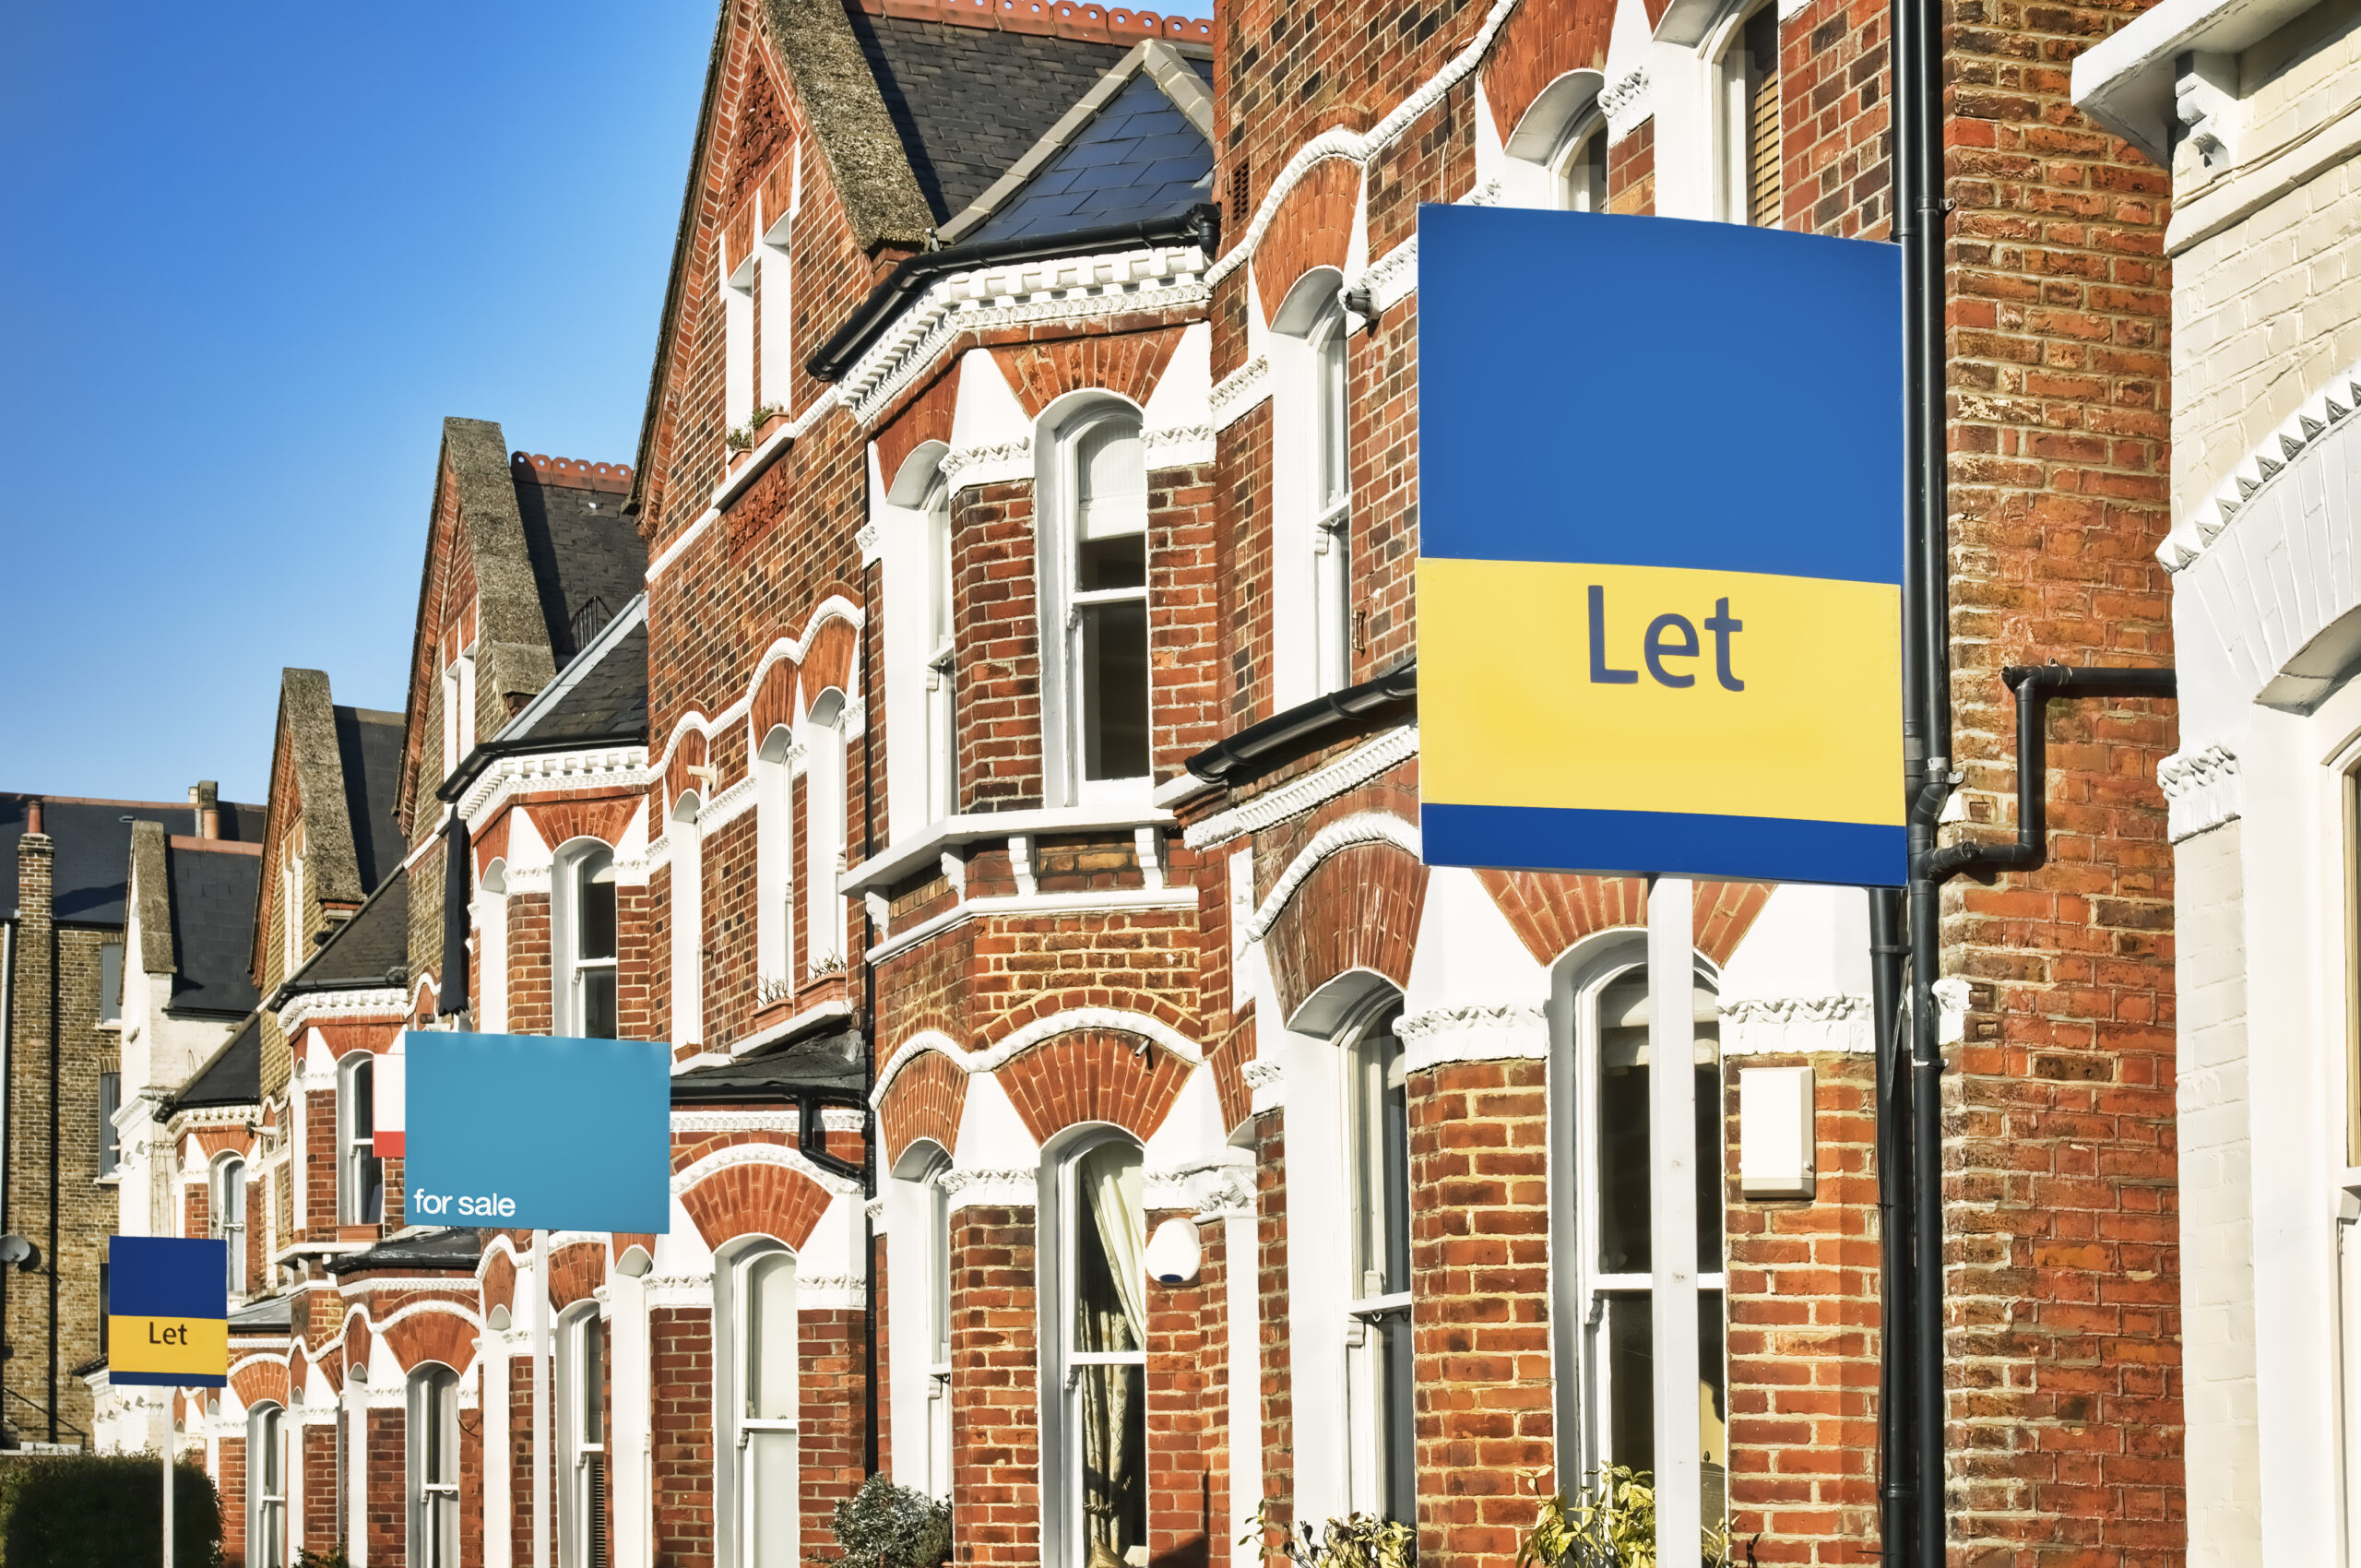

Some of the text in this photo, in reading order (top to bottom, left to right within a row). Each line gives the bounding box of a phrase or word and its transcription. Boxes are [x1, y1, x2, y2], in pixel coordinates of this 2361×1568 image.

[1587, 585, 1745, 692] Let
[413, 1188, 516, 1217] for sale
[148, 1321, 188, 1345] Let
